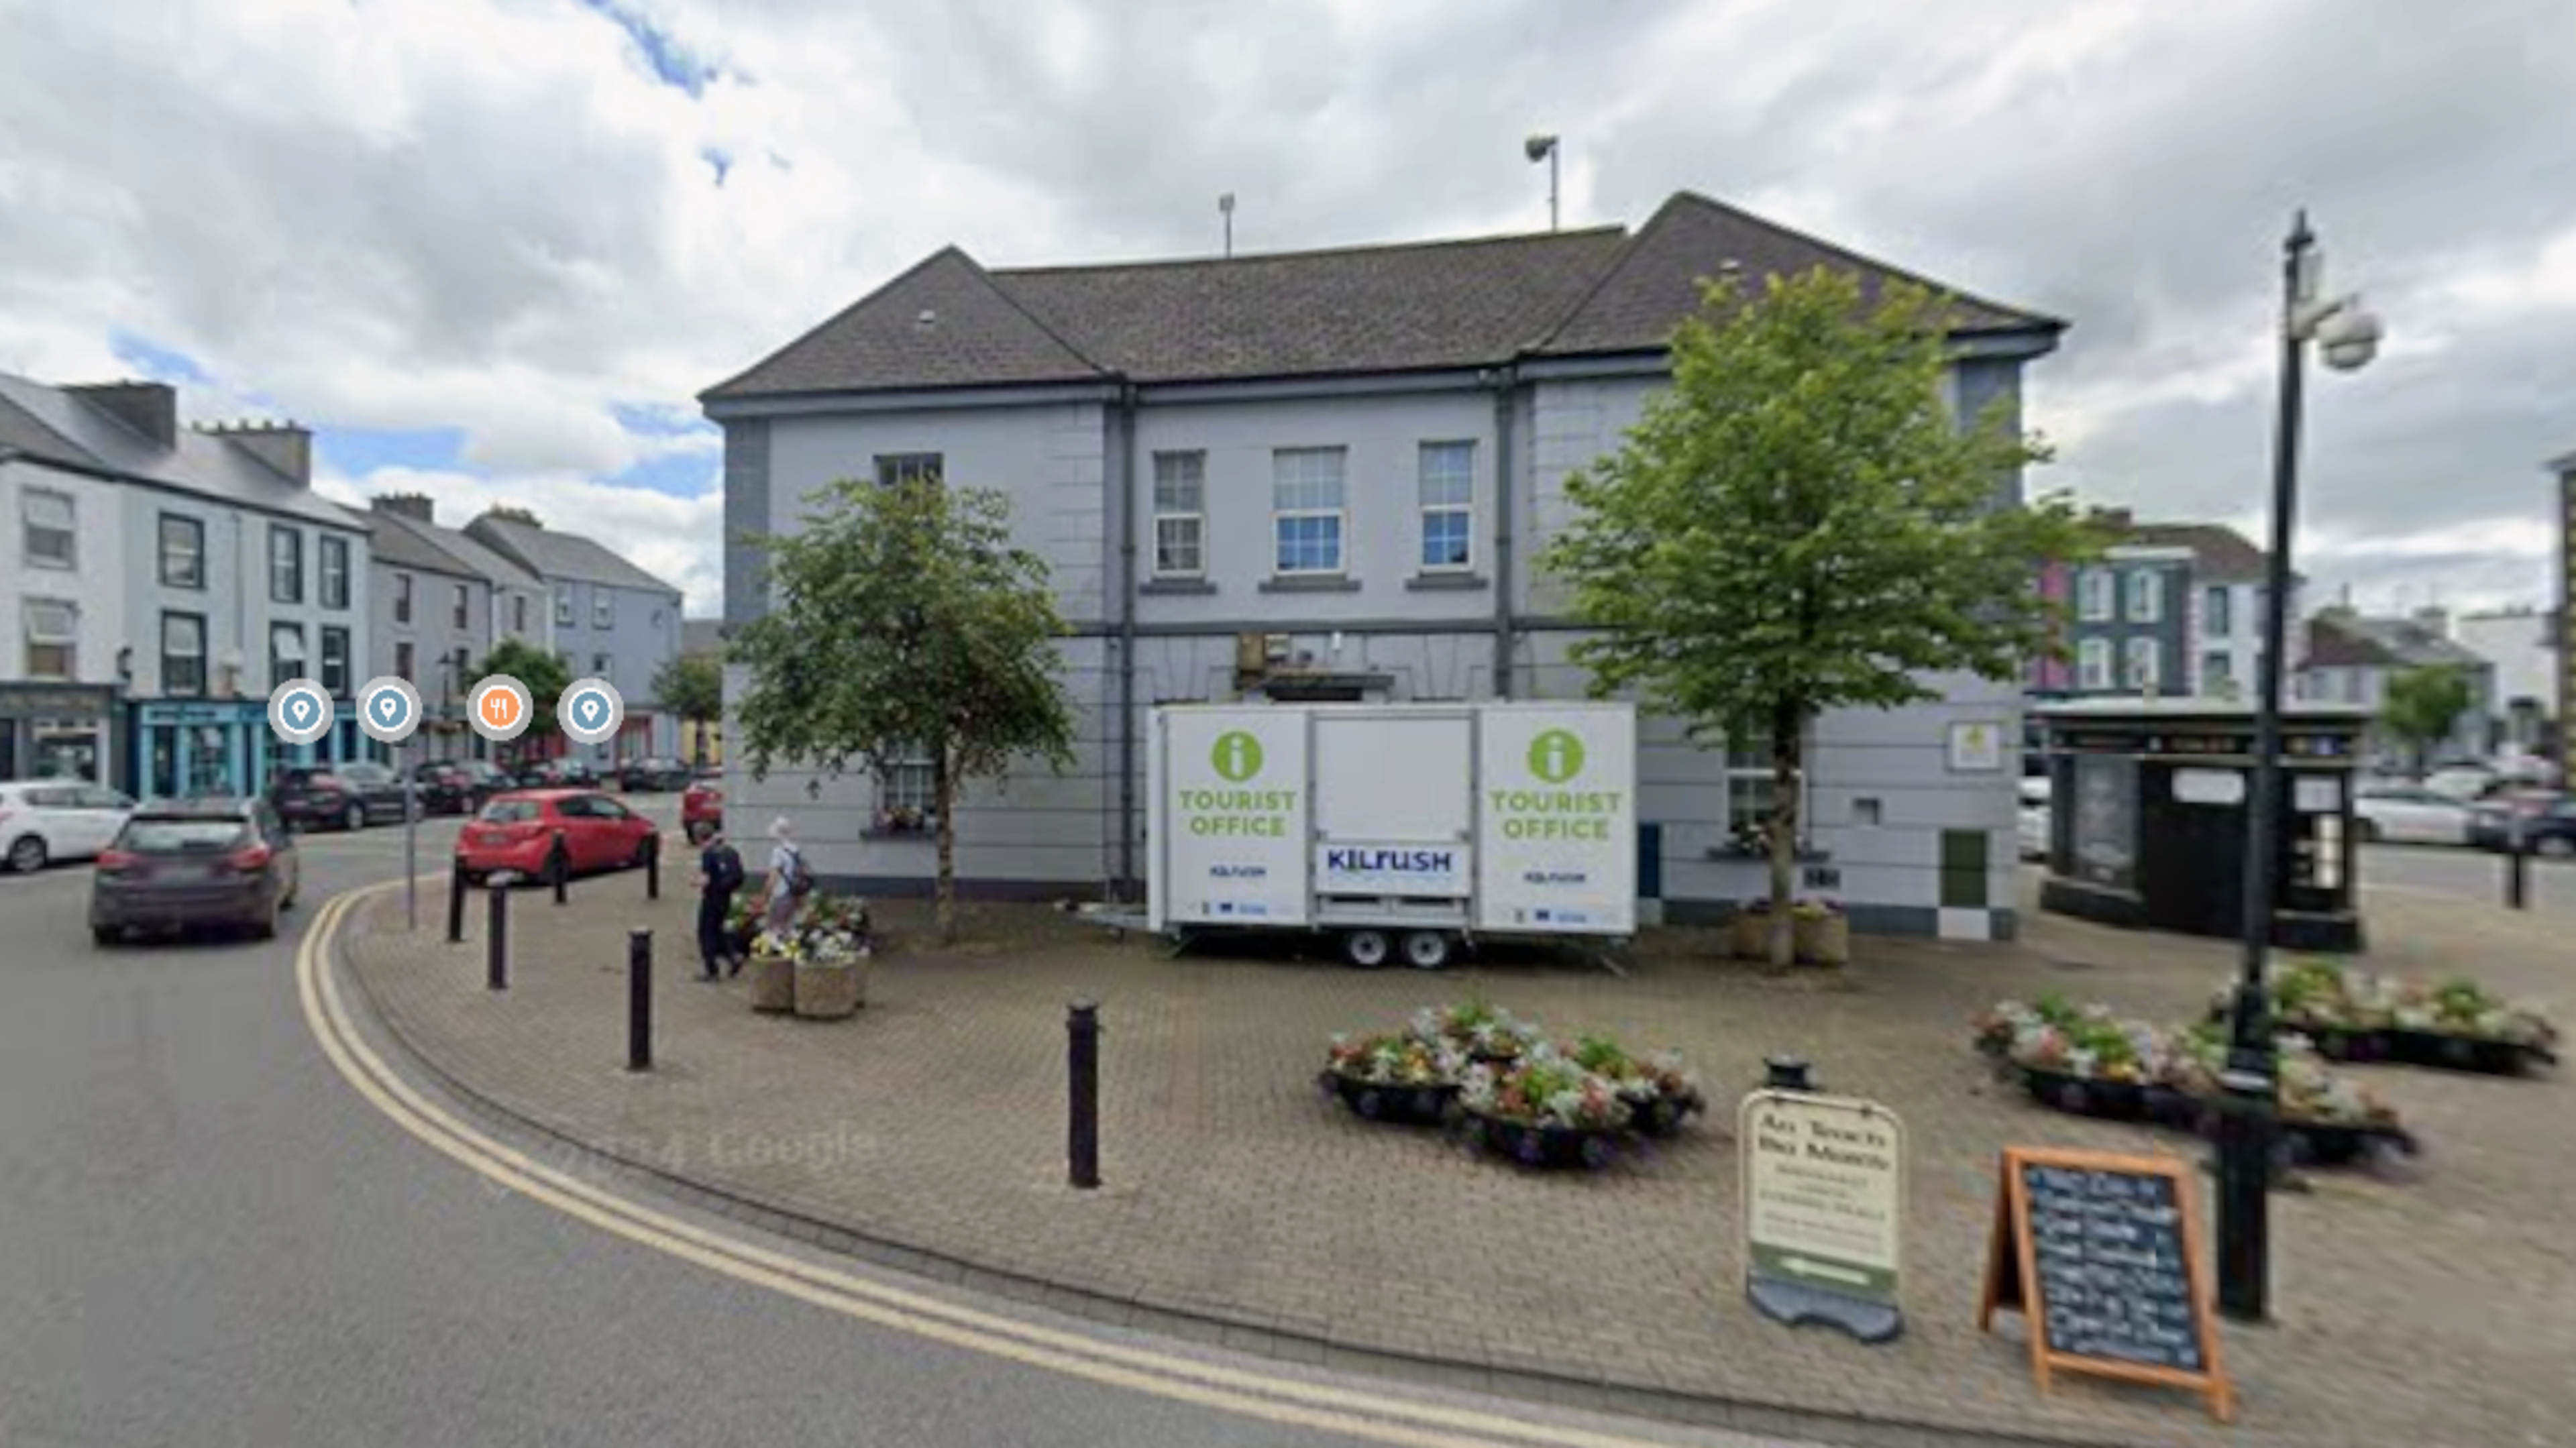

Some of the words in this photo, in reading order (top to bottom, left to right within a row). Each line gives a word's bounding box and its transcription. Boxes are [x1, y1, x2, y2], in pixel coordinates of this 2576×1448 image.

[1179, 790, 1296, 811] TOURIST
[1489, 790, 1621, 813] TOURIST
[1191, 816, 1286, 836] OFFICE
[1503, 818, 1609, 839] OFFICE
